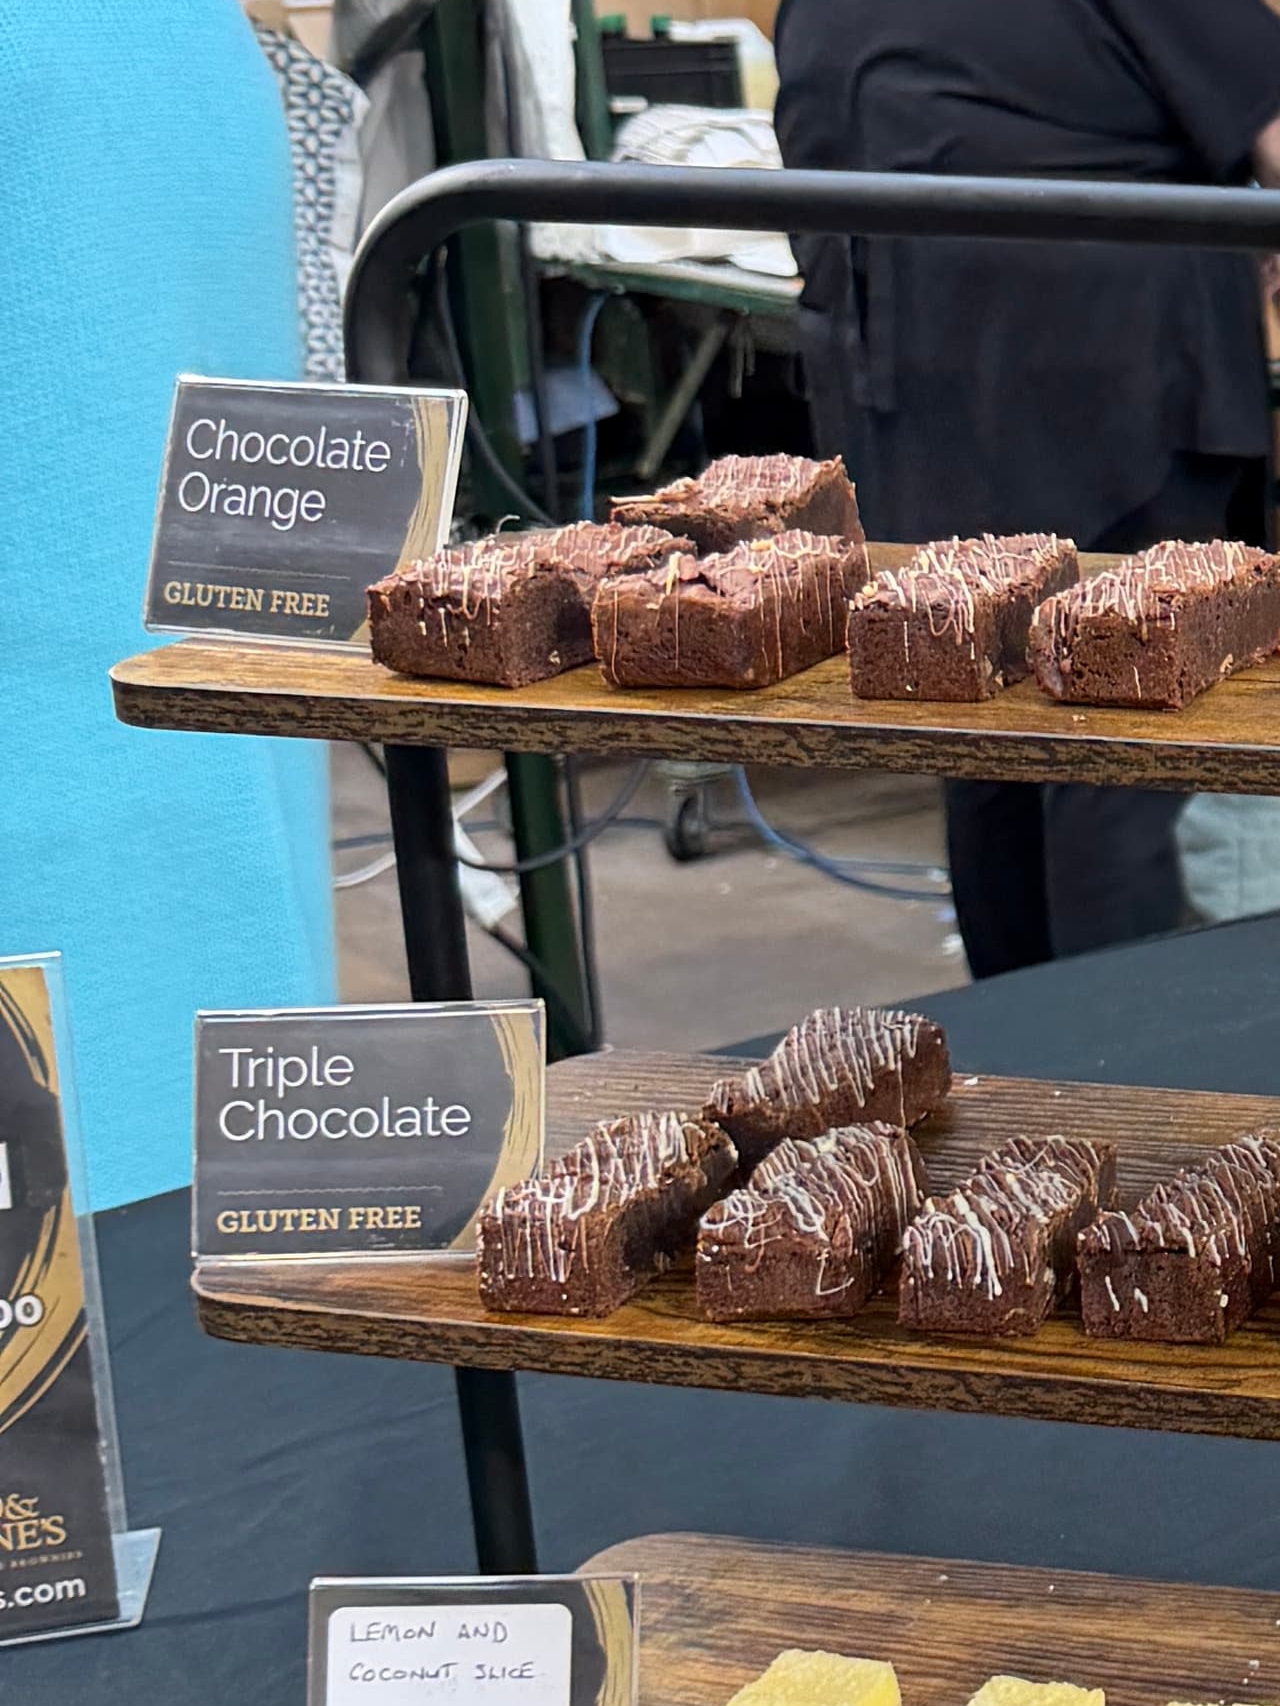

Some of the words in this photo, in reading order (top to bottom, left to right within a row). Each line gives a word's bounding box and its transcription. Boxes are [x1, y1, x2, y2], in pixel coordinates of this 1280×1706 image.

[187, 418, 391, 472] Chocolate
[178, 471, 326, 531] Orange
[164, 581, 264, 612] GLUTEN
[270, 594, 330, 617] FREE
[218, 1046, 354, 1099] Triple
[219, 1096, 471, 1141] Chocolate
[216, 1208, 342, 1233] GLUTEN
[349, 1206, 421, 1230] FREE
[350, 1621, 436, 1642] LEMON
[458, 1623, 508, 1643] AND
[349, 1662, 459, 1682] COCONUT
[475, 1661, 536, 1680] SLICE
